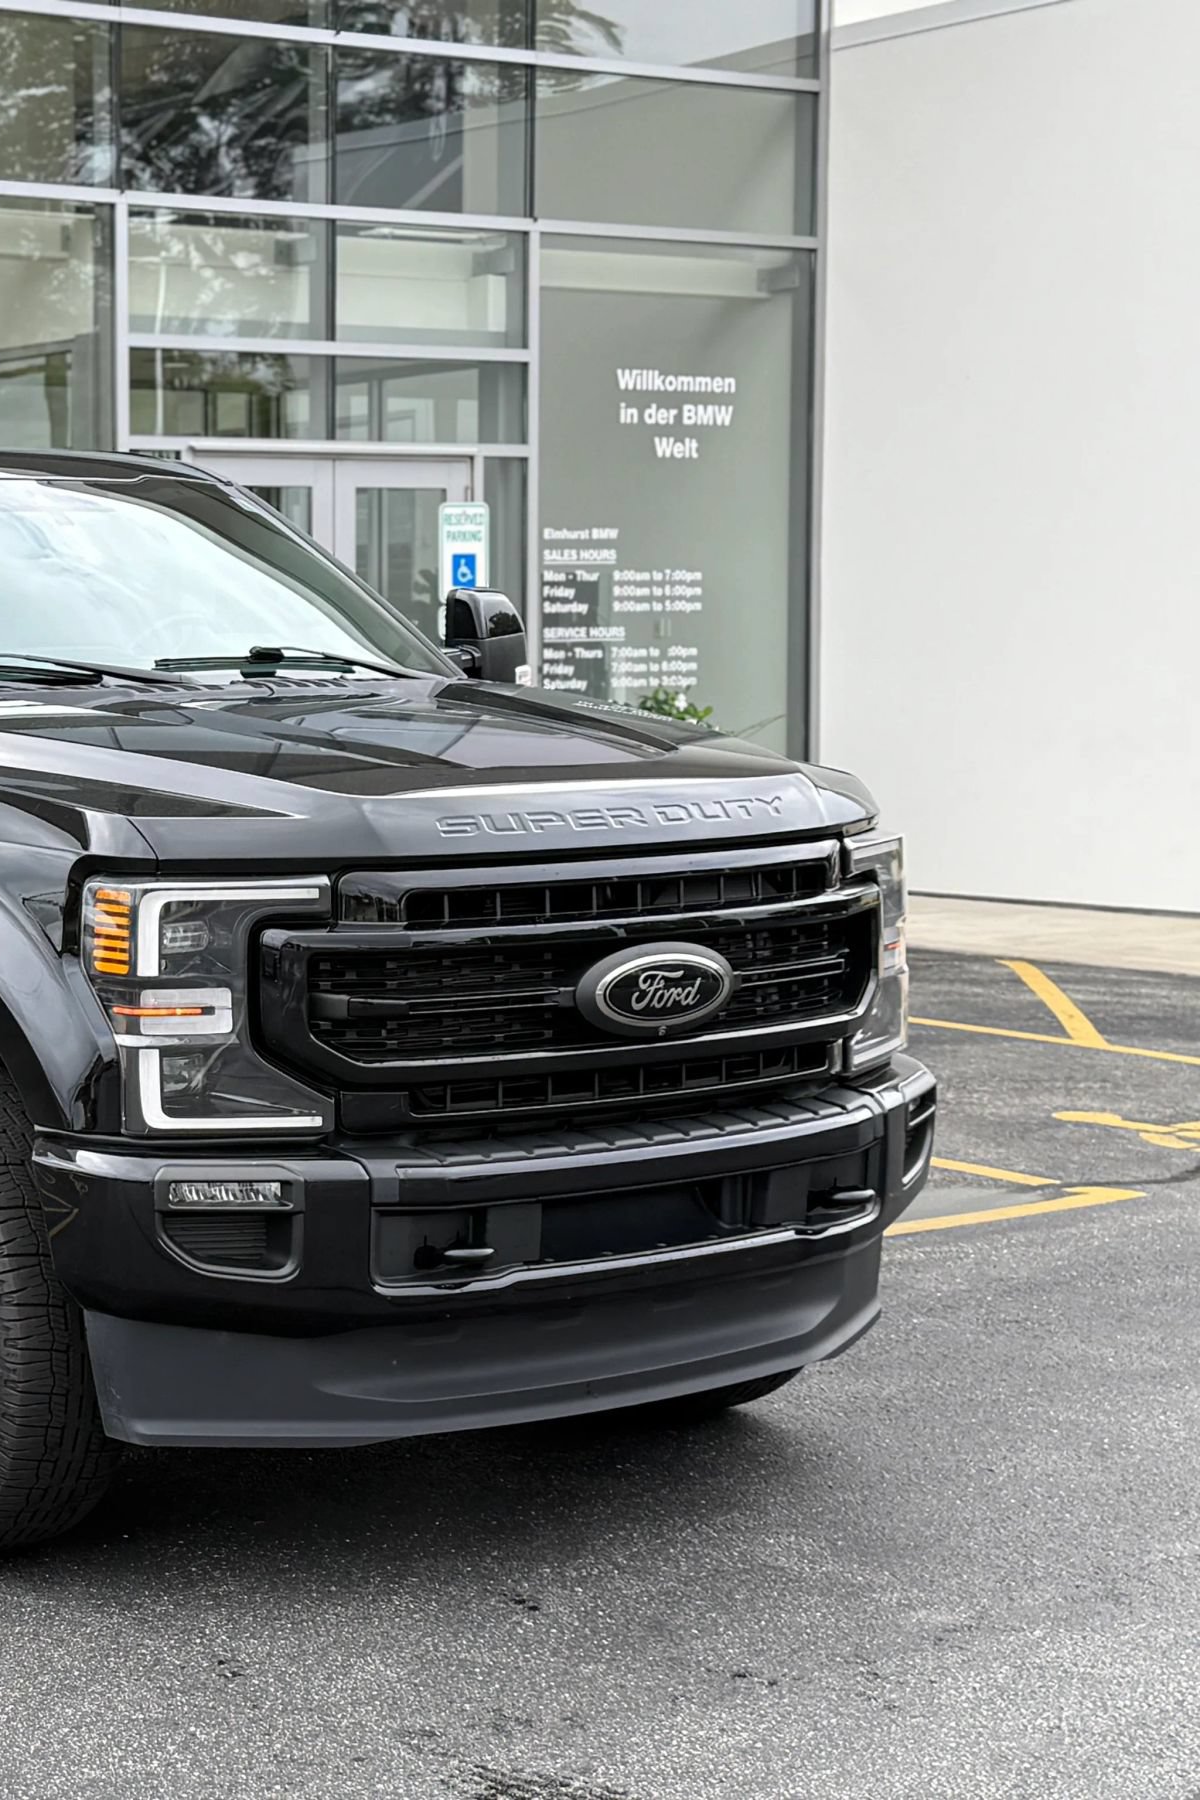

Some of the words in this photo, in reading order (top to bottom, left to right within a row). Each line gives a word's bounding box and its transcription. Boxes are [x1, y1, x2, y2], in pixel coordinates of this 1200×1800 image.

[617, 368, 736, 394] Willkommen
[620, 402, 638, 424] in
[644, 403, 678, 425] der
[682, 404, 733, 426] BMW
[654, 436, 698, 459] Welt
[443, 512, 484, 526] RESERVED
[446, 530, 482, 542] PARKING
[543, 528, 589, 540] Elmhurst
[591, 528, 619, 540] BMW
[543, 549, 578, 561] SALES
[579, 549, 616, 561] HOURS
[543, 570, 566, 582] Mon
[575, 570, 599, 582] Thur
[652, 570, 663, 581] to
[543, 586, 576, 600] Friday
[652, 585, 663, 597] to
[543, 601, 589, 615] Saturday
[652, 600, 663, 612] to
[543, 626, 587, 639] SERVICE
[589, 626, 625, 639] HOURS
[543, 648, 566, 660] Mon
[574, 647, 603, 660] Thurs
[649, 646, 660, 658] to
[543, 663, 575, 677] Friday
[649, 661, 660, 673] to
[435, 807, 648, 838] SUPER
[653, 795, 783, 827] DUTY
[631, 970, 702, 1011] Ford
